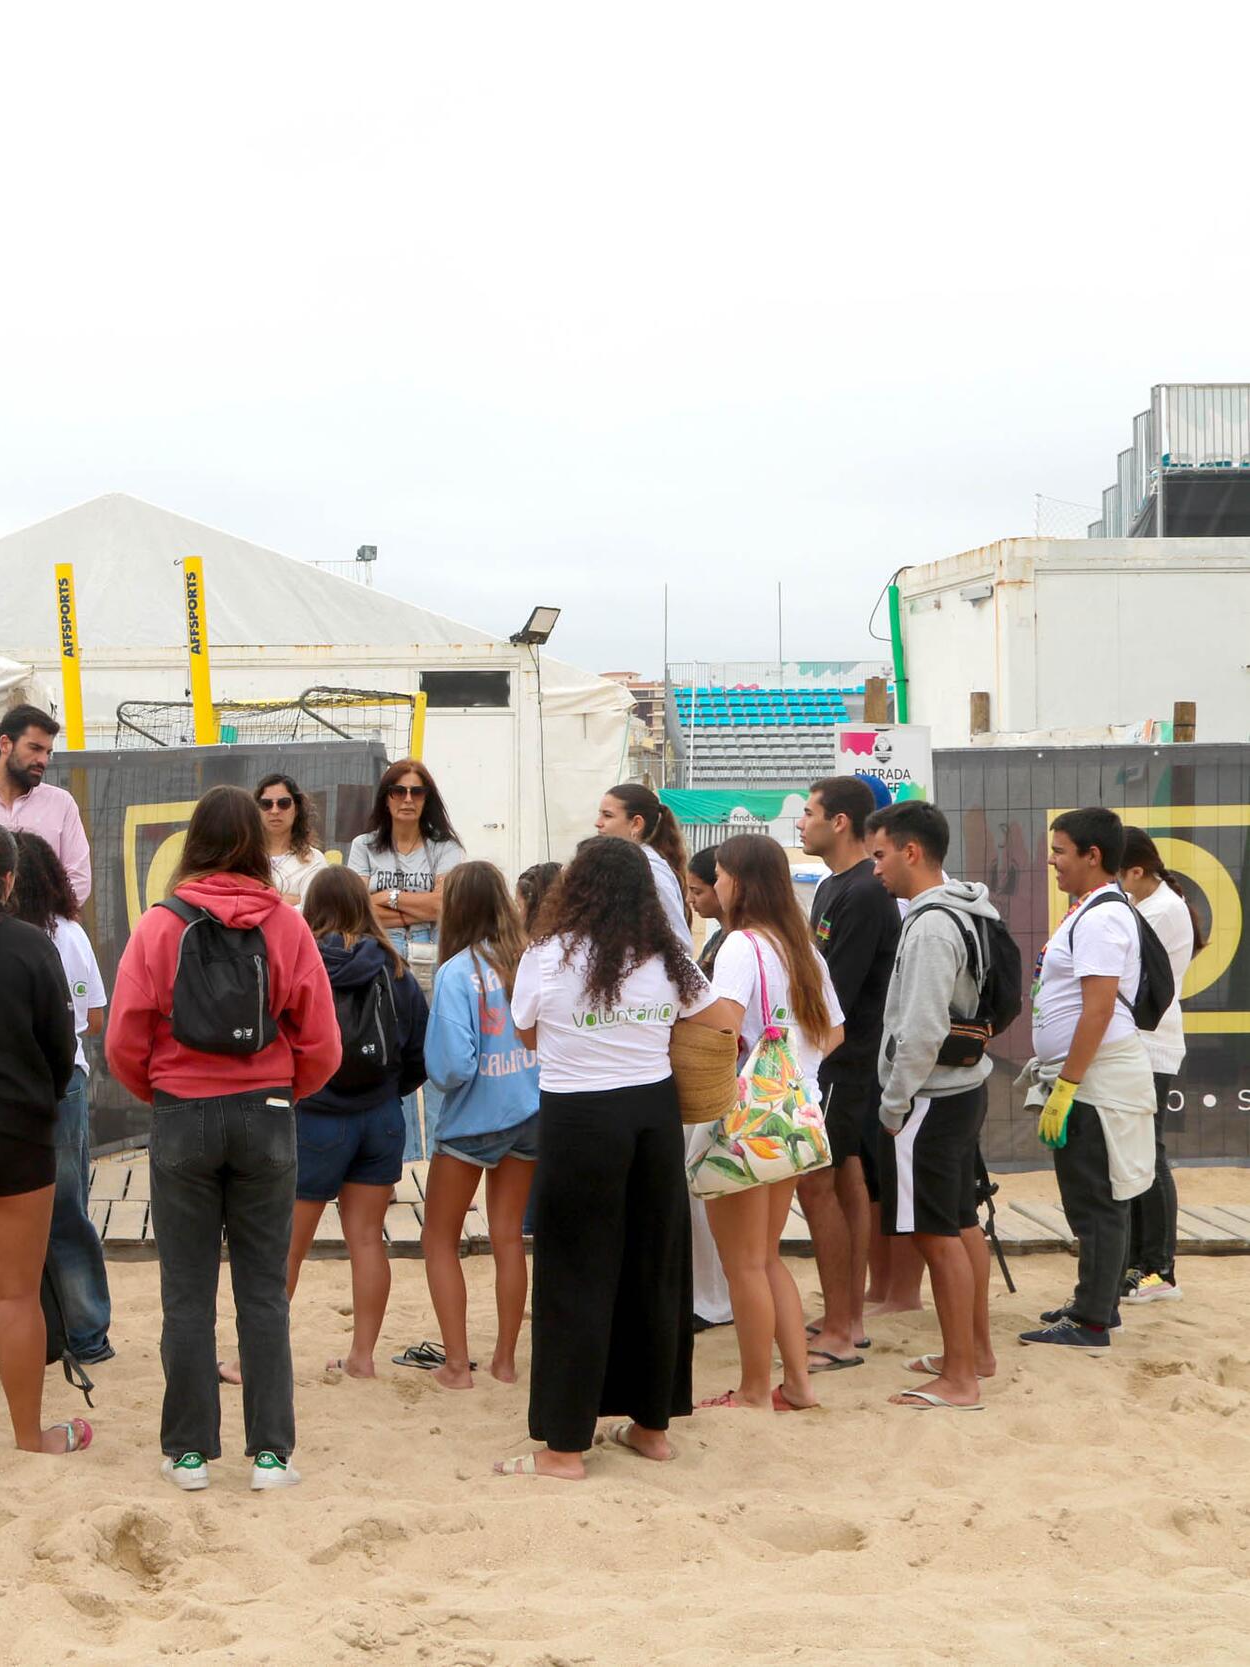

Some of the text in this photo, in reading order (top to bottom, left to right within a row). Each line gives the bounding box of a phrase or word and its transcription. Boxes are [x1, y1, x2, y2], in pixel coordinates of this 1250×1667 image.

[58, 577, 75, 658] AFFSPORTS
[185, 571, 201, 655] AFFSPORTS
[478, 1048, 538, 1077] CALIFO
